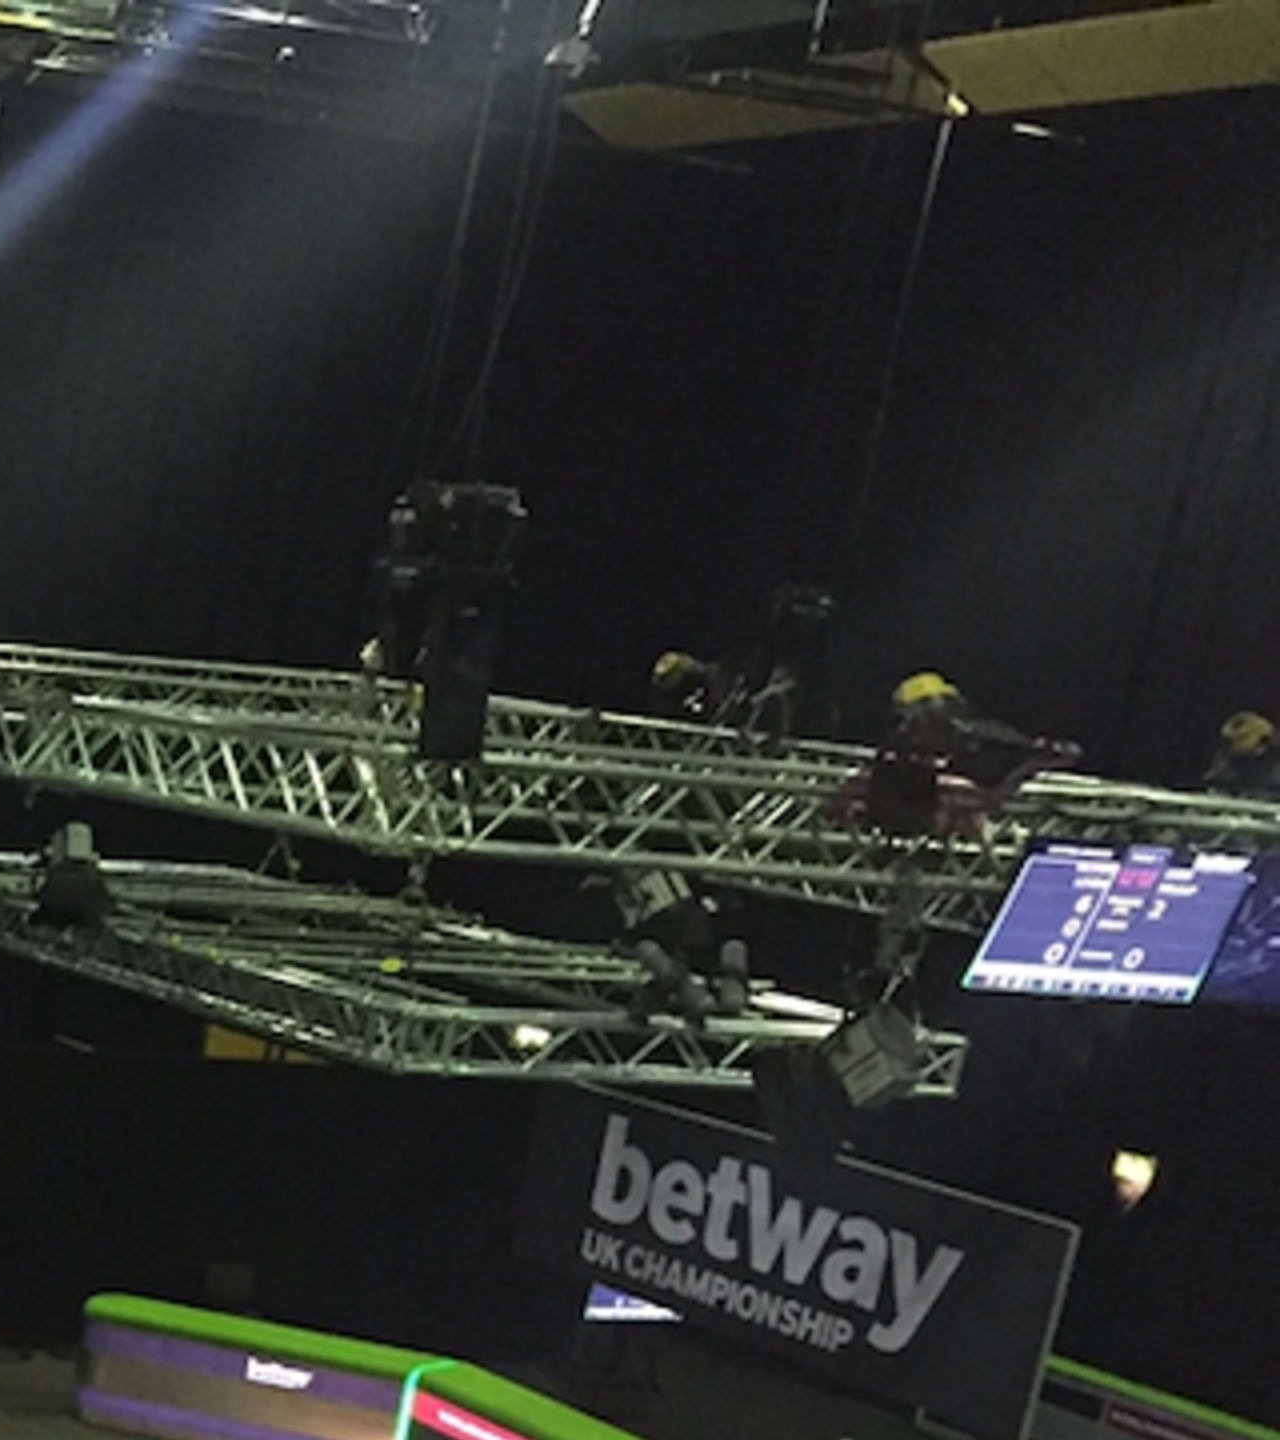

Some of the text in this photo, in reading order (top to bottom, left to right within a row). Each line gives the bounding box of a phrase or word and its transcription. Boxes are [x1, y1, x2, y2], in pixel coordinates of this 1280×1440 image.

[581, 1227, 855, 1353] UK CHAMPIONSHIP
[590, 1113, 964, 1354] betway
